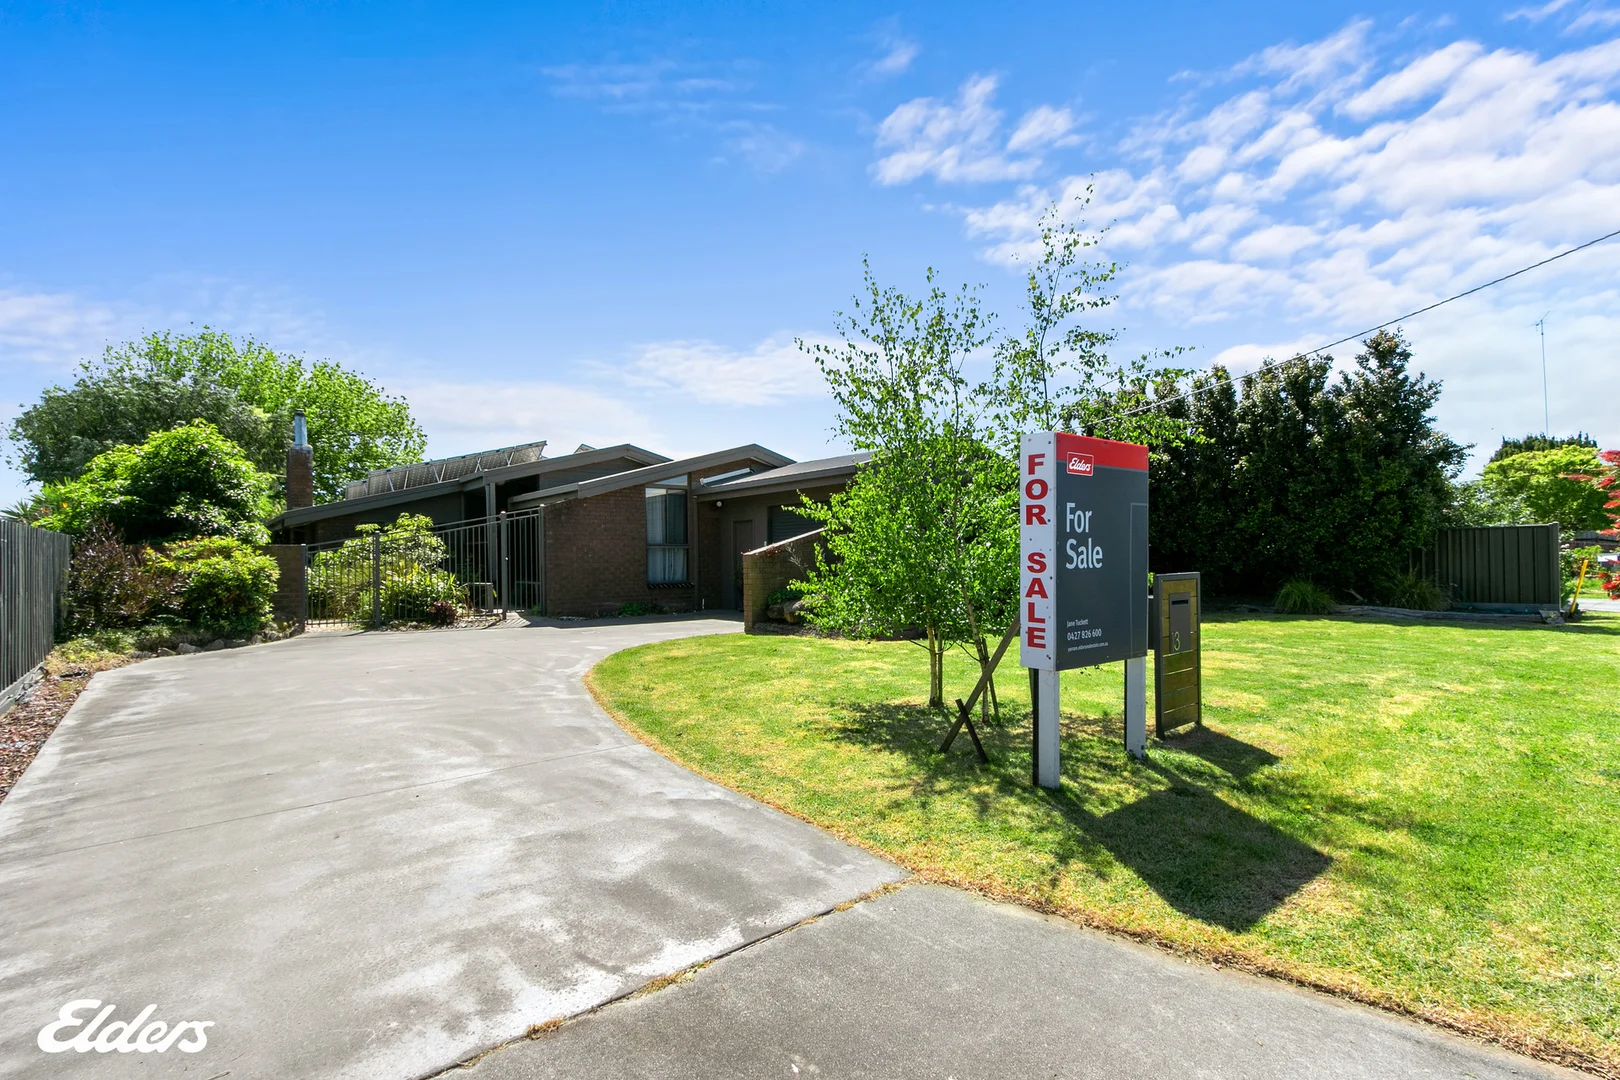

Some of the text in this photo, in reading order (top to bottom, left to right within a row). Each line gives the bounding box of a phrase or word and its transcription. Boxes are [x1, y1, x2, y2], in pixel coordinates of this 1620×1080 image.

[1069, 457, 1091, 471] Elders
[1066, 502, 1092, 533] For
[1025, 453, 1048, 649] FOR SALE
[1065, 538, 1103, 569] Sale
[1067, 628, 1102, 641] 0427 826 600
